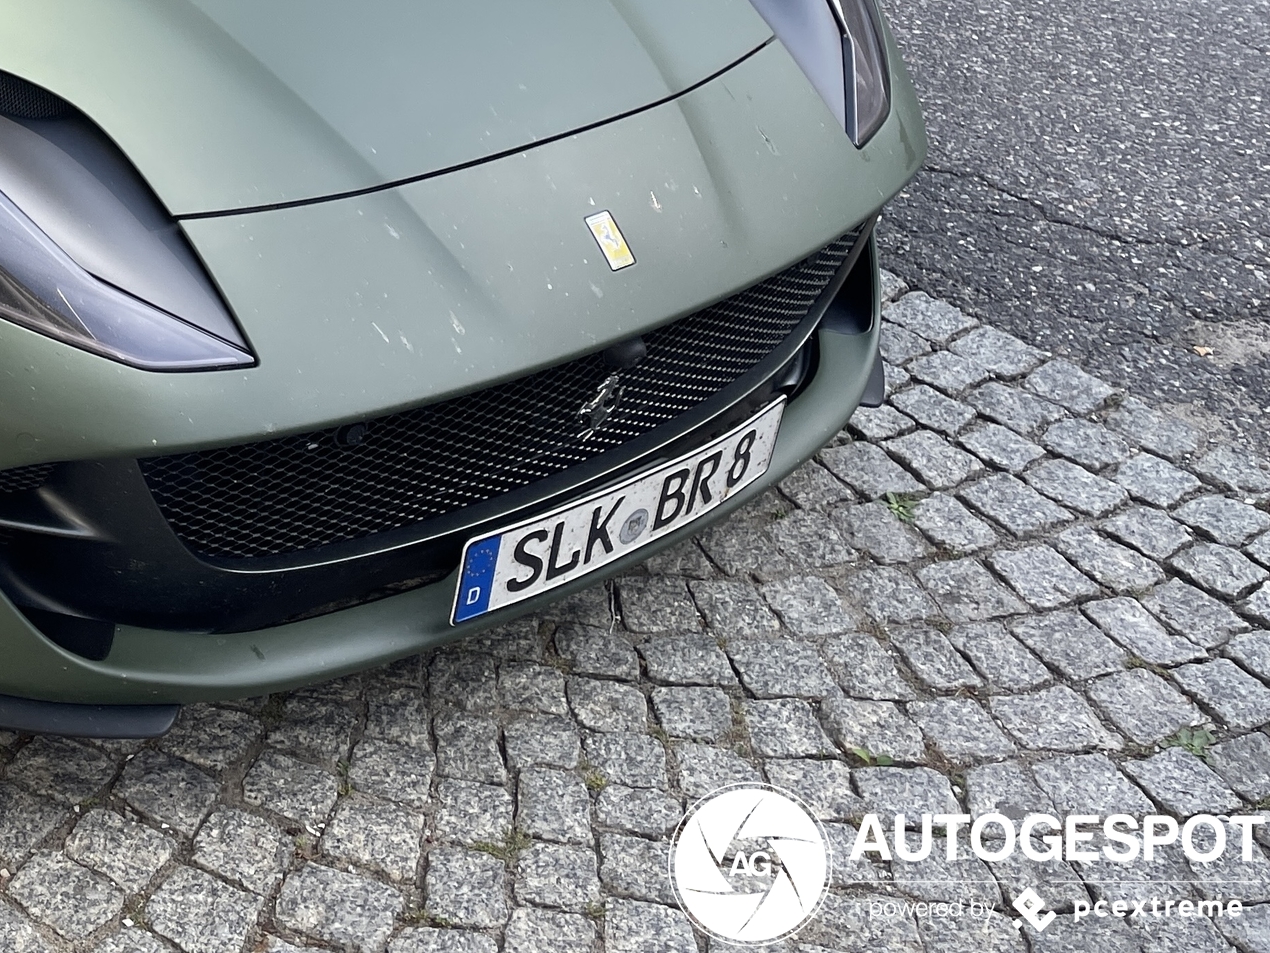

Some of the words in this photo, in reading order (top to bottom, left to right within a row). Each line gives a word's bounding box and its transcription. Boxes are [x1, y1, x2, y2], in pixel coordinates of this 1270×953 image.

[506, 495, 626, 592] SLK
[652, 450, 723, 532] BR
[727, 429, 757, 488] 8
[466, 586, 481, 606] D
